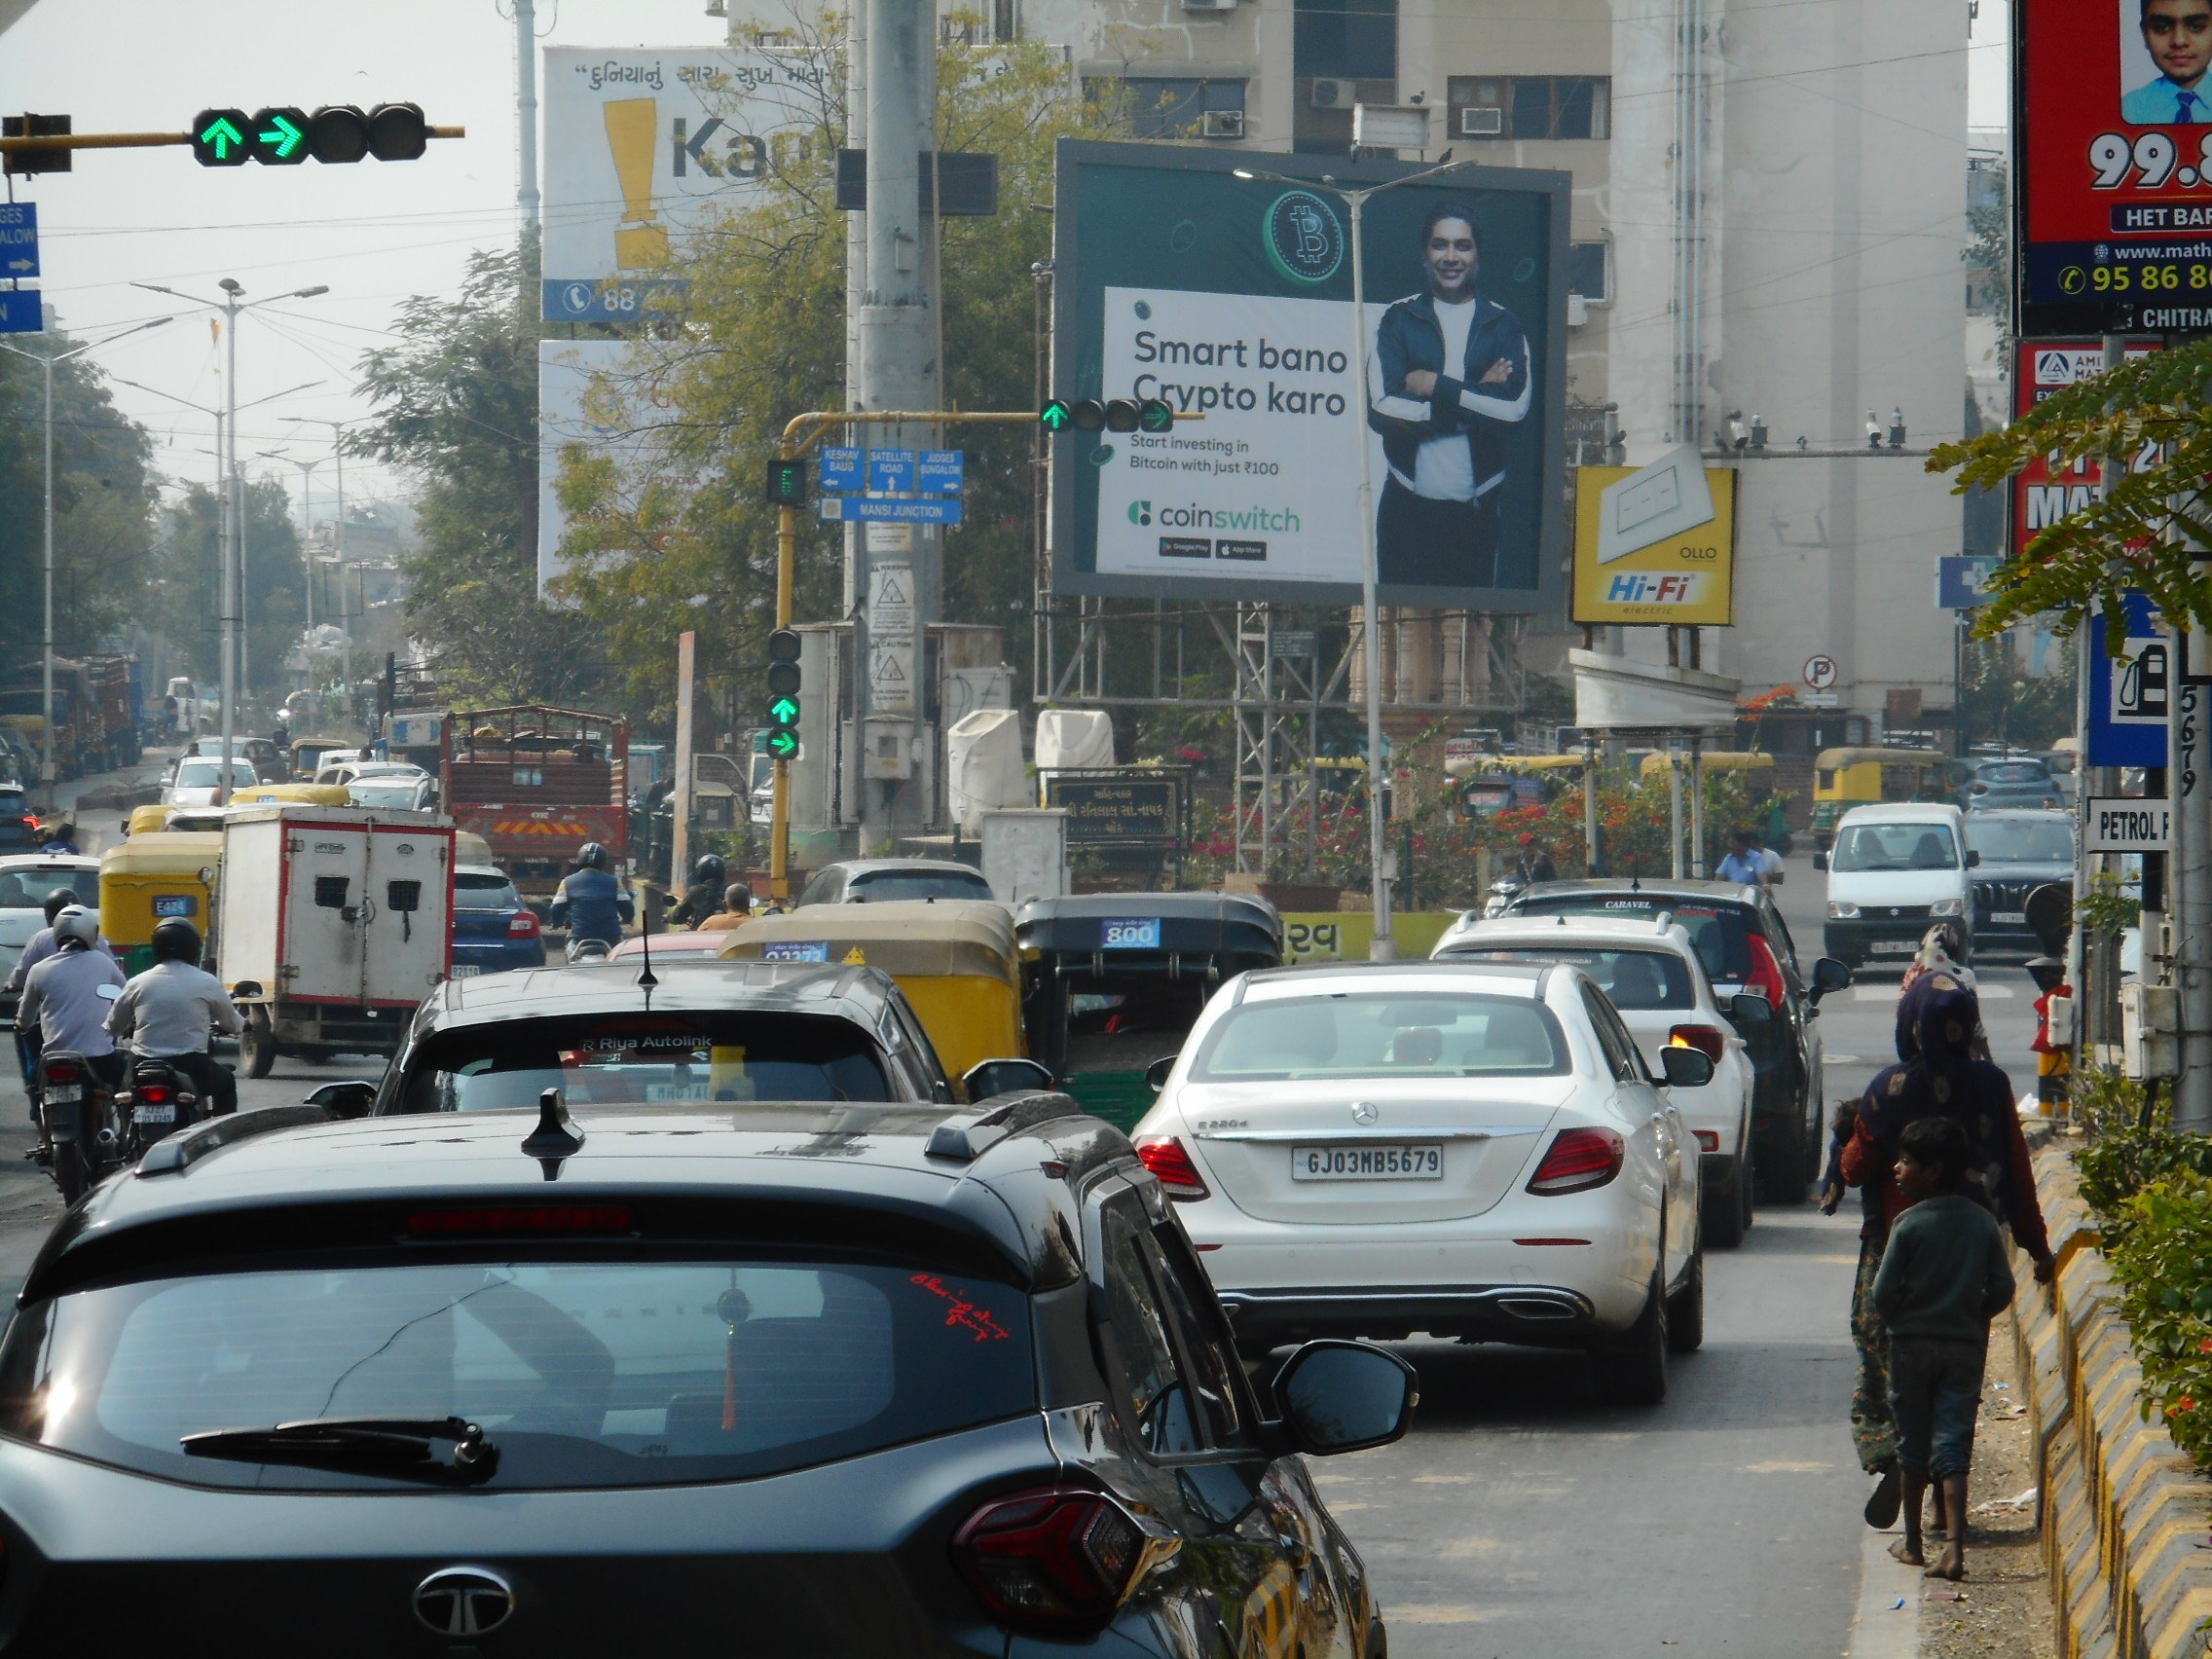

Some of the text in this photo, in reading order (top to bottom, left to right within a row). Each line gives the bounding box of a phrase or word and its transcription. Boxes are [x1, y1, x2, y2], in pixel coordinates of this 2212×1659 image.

[2126, 208, 2168, 227] HET
[2093, 264, 2212, 291] 95 86 8
[1134, 331, 1347, 374] Smart bano
[1133, 374, 1346, 416] Crypto karo
[1130, 434, 1249, 456] Start investing in
[826, 451, 860, 461] KESHAV
[870, 452, 912, 462] SATELLITE
[927, 454, 955, 463] JUDGES
[830, 461, 854, 472] BAUG
[880, 464, 903, 474] ROAD
[920, 464, 961, 475] BUNGALOW
[1130, 456, 1178, 470] Bitcoin
[1182, 459, 1211, 472] with
[1213, 461, 1240, 476] just
[860, 504, 942, 518] MANSI JUNCTION
[1160, 502, 1301, 533] coinswitch
[1679, 547, 1716, 559] OLLO
[1607, 575, 1689, 602] Hi-Fi
[1623, 606, 1673, 614] electric
[2100, 811, 2157, 840] PETROL
[1605, 901, 1652, 909] CARAVEL
[1107, 927, 1153, 943] 800
[600, 1038, 638, 1051] Riya
[643, 1036, 713, 1048] Autolink
[1308, 1151, 1439, 1174] GJ03MB5679
